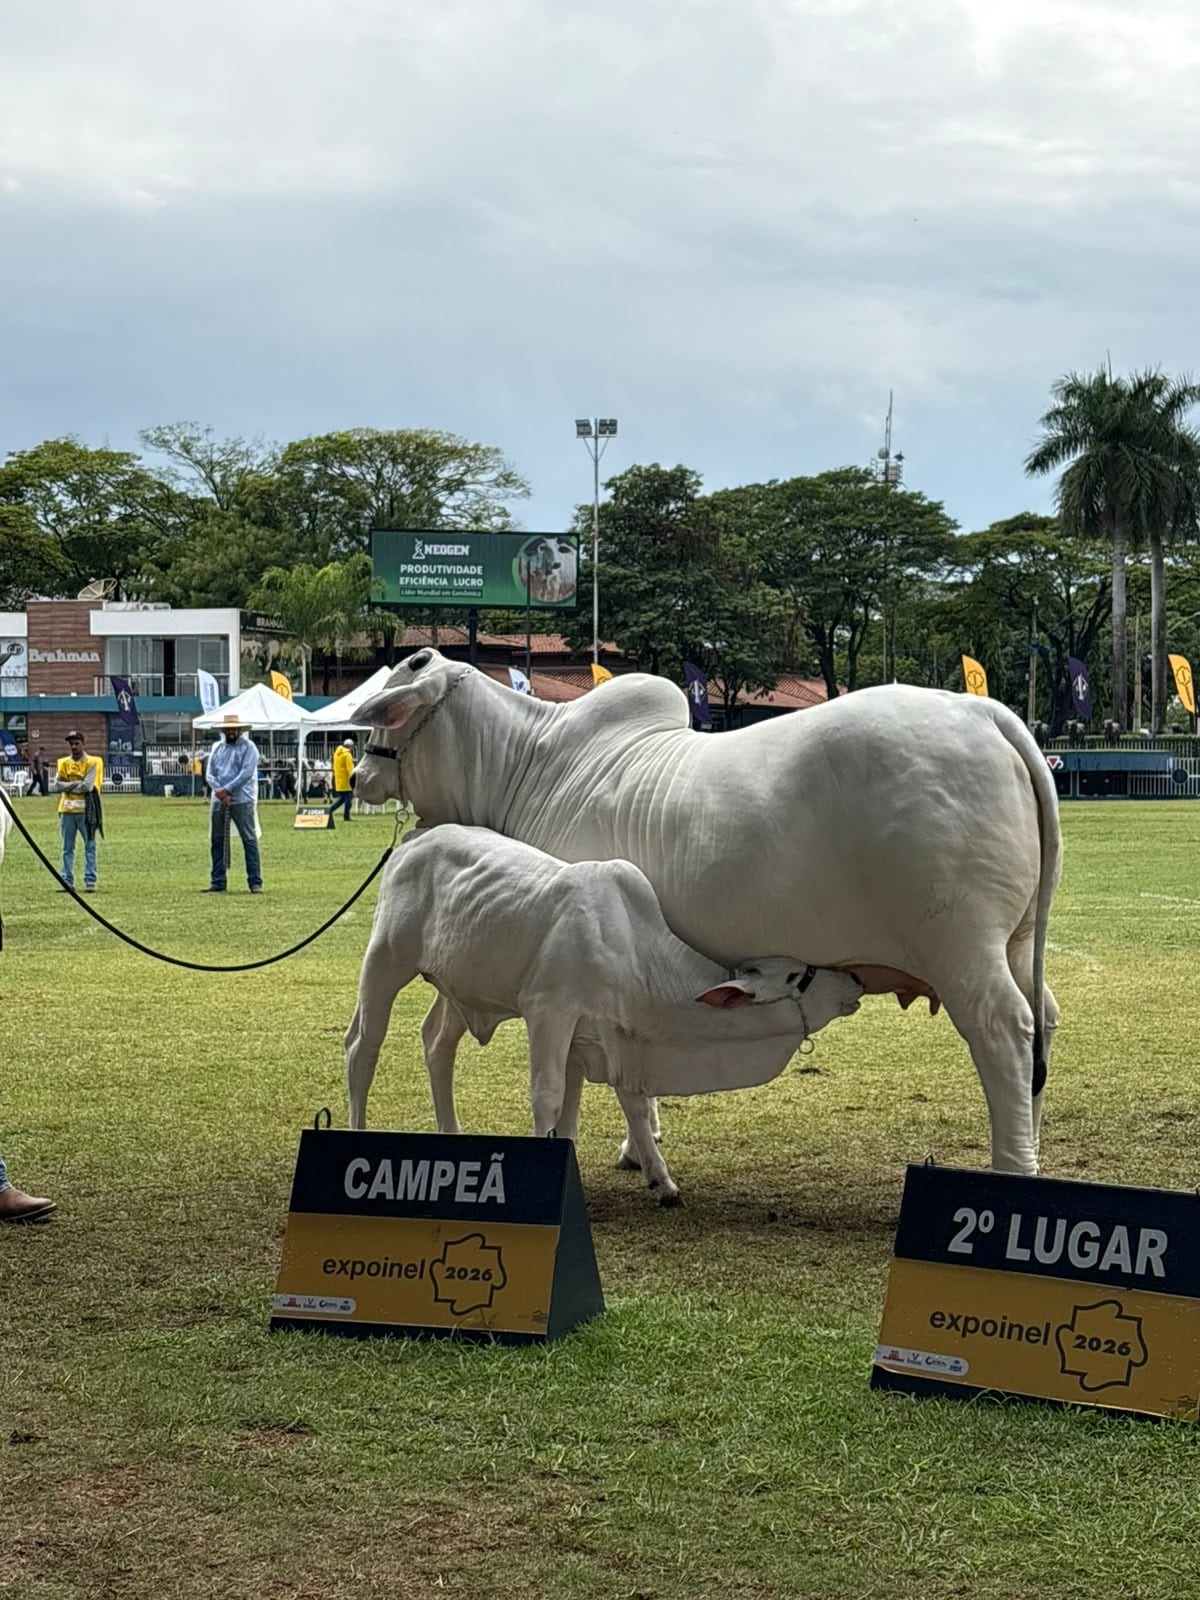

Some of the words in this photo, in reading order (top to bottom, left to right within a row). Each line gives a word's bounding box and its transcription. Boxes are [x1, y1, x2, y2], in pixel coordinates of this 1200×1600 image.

[424, 544, 470, 556] NEOGEN
[400, 564, 484, 575] PRODUTIVIDADE
[399, 575, 449, 586] EFICIÊNCIA
[453, 578, 484, 586] LUCRO
[29, 648, 101, 663] Brahman
[344, 1152, 506, 1204] CAMPEÃ
[1005, 1213, 1169, 1278] LUGAR
[322, 1256, 426, 1281] expoinel
[444, 1266, 493, 1282] 2026
[929, 1309, 1051, 1346] expoinel
[1072, 1334, 1132, 1356] 2026
